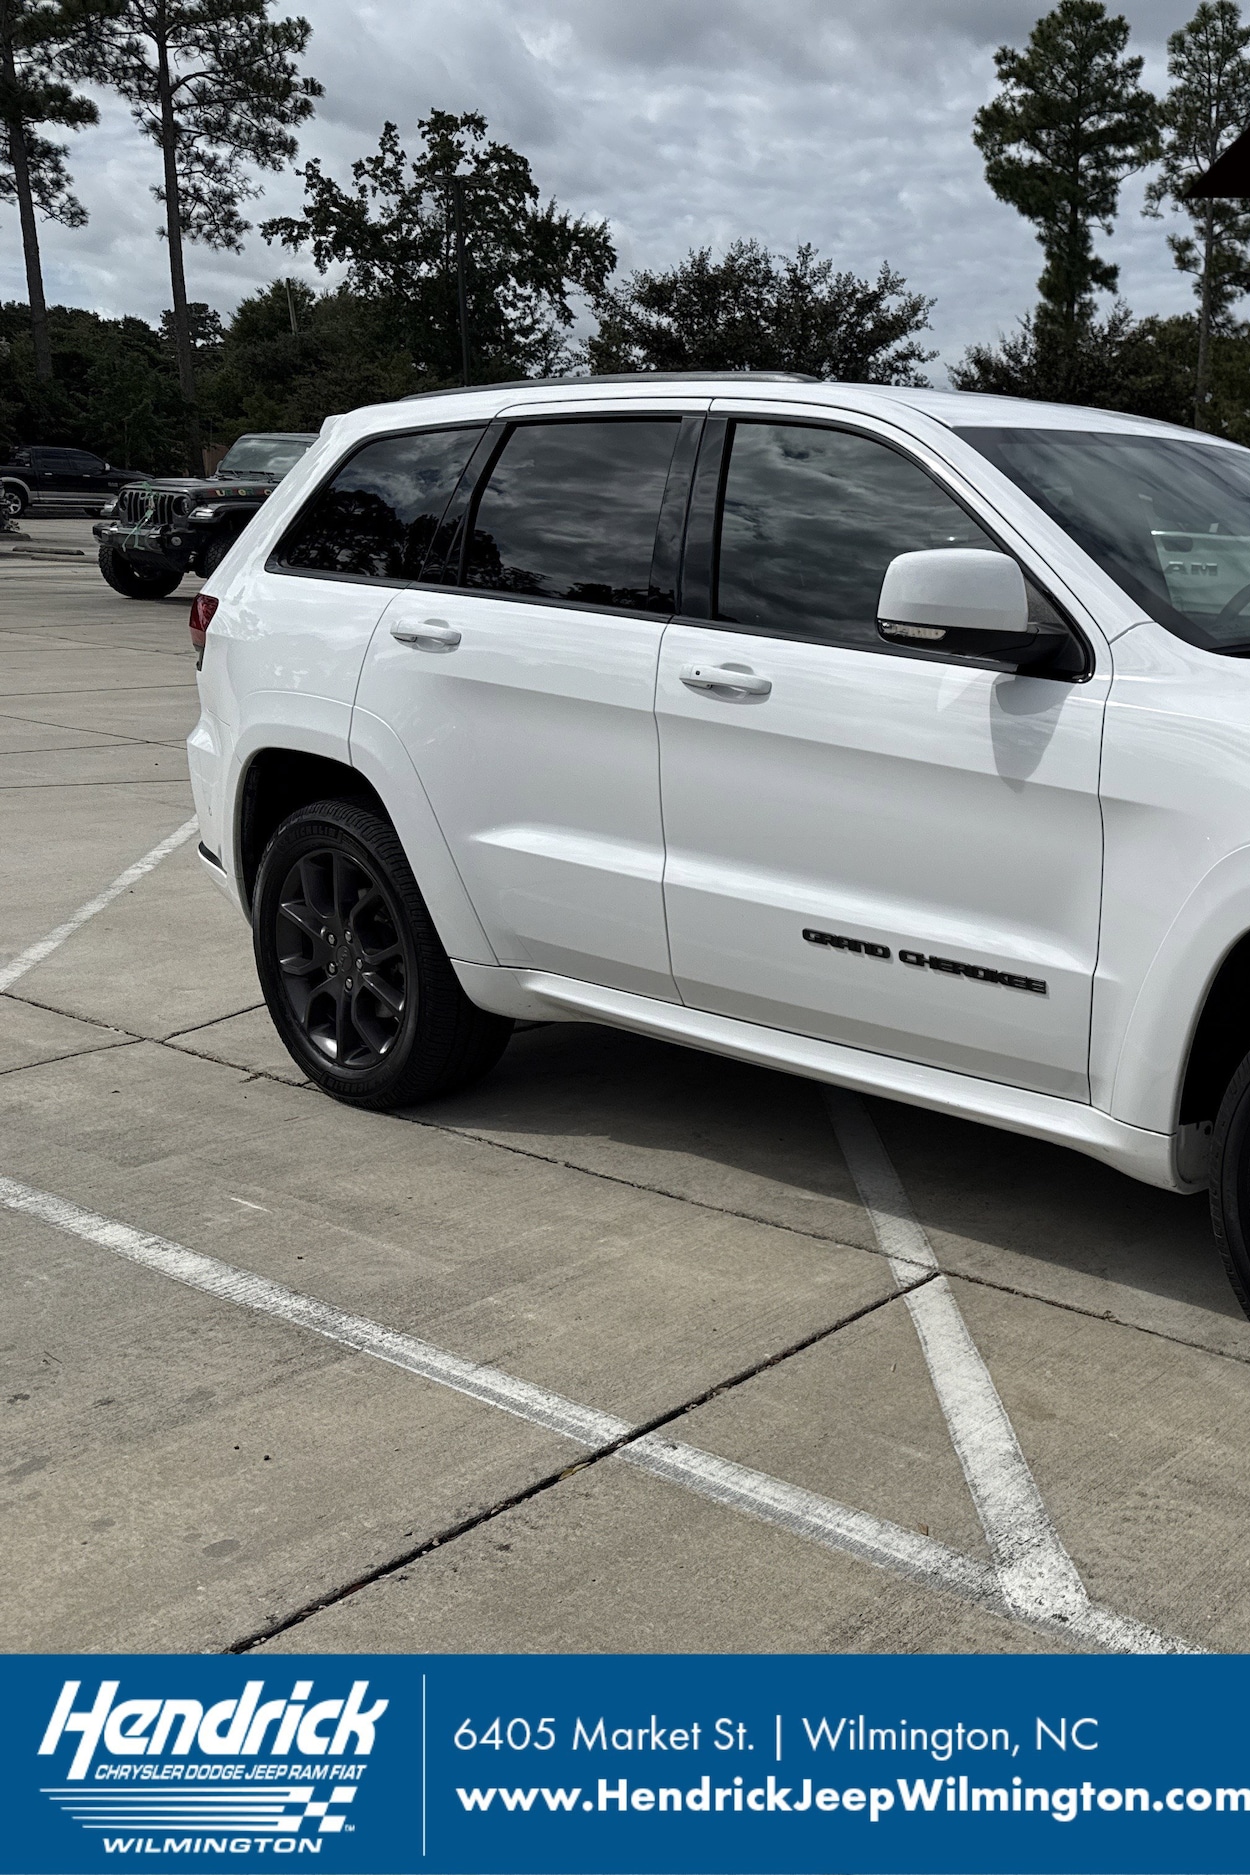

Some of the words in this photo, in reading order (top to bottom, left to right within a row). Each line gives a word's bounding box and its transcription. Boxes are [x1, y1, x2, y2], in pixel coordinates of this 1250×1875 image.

[1164, 560, 1219, 576] AM
[802, 928, 891, 959] GRAND
[899, 949, 1047, 994] CHEROKEE
